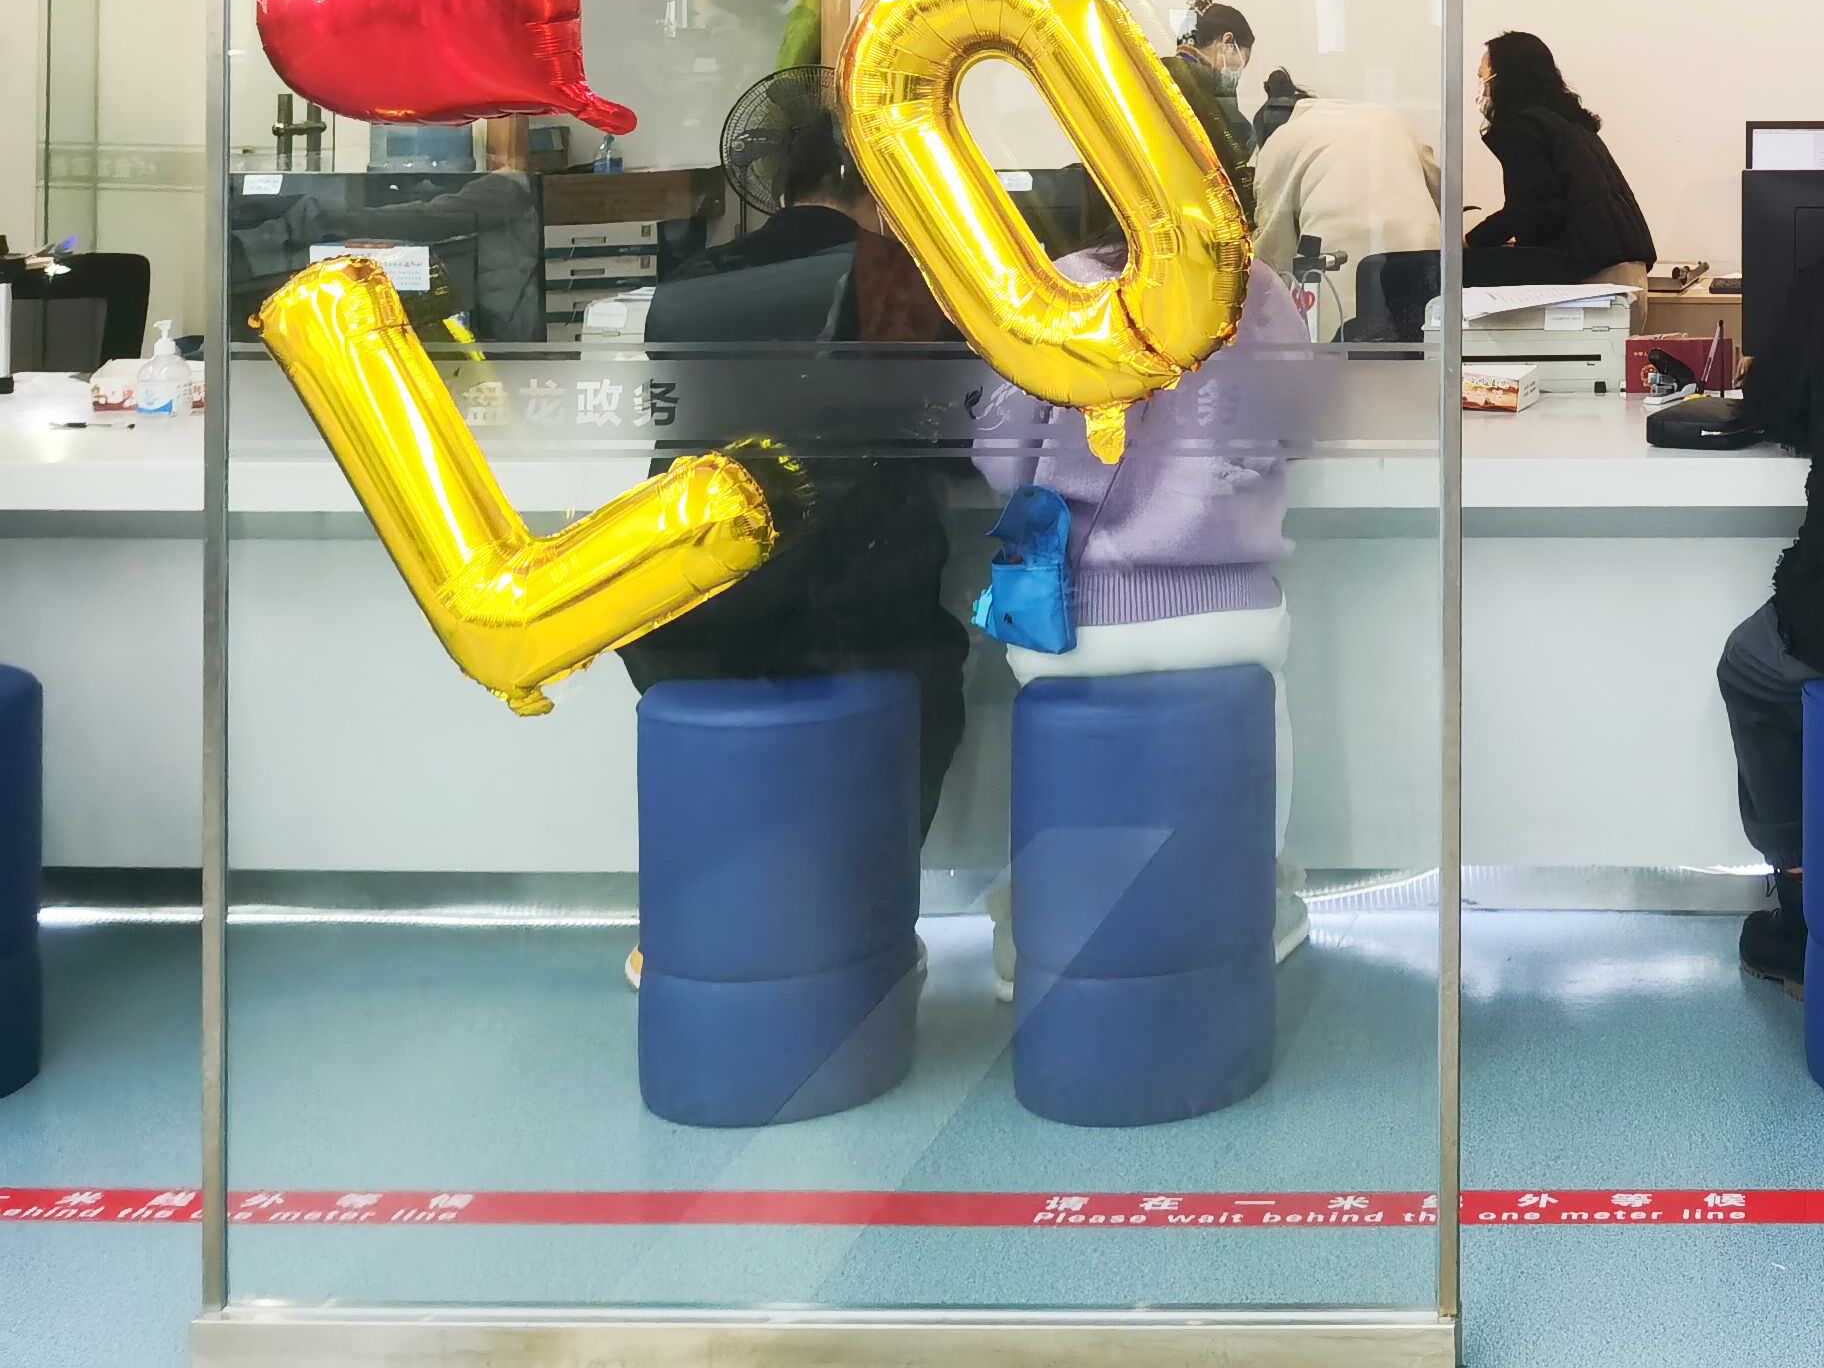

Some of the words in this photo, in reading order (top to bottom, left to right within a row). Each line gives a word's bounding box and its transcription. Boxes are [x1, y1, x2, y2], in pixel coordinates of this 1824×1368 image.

[463, 378, 680, 427] 盘龙政务
[0, 1205, 105, 1219] ehind
[116, 1206, 175, 1220] the
[190, 1208, 254, 1221] oe
[268, 1209, 377, 1222] meter
[388, 1208, 459, 1222] line
[1032, 1211, 1148, 1224] Please
[1167, 1212, 1244, 1224] wait
[1262, 1211, 1385, 1223] behind
[1403, 1211, 1437, 1223] th
[1478, 1211, 1542, 1220] one
[1560, 1209, 1664, 1220] meter
[1682, 1208, 1747, 1220] line
